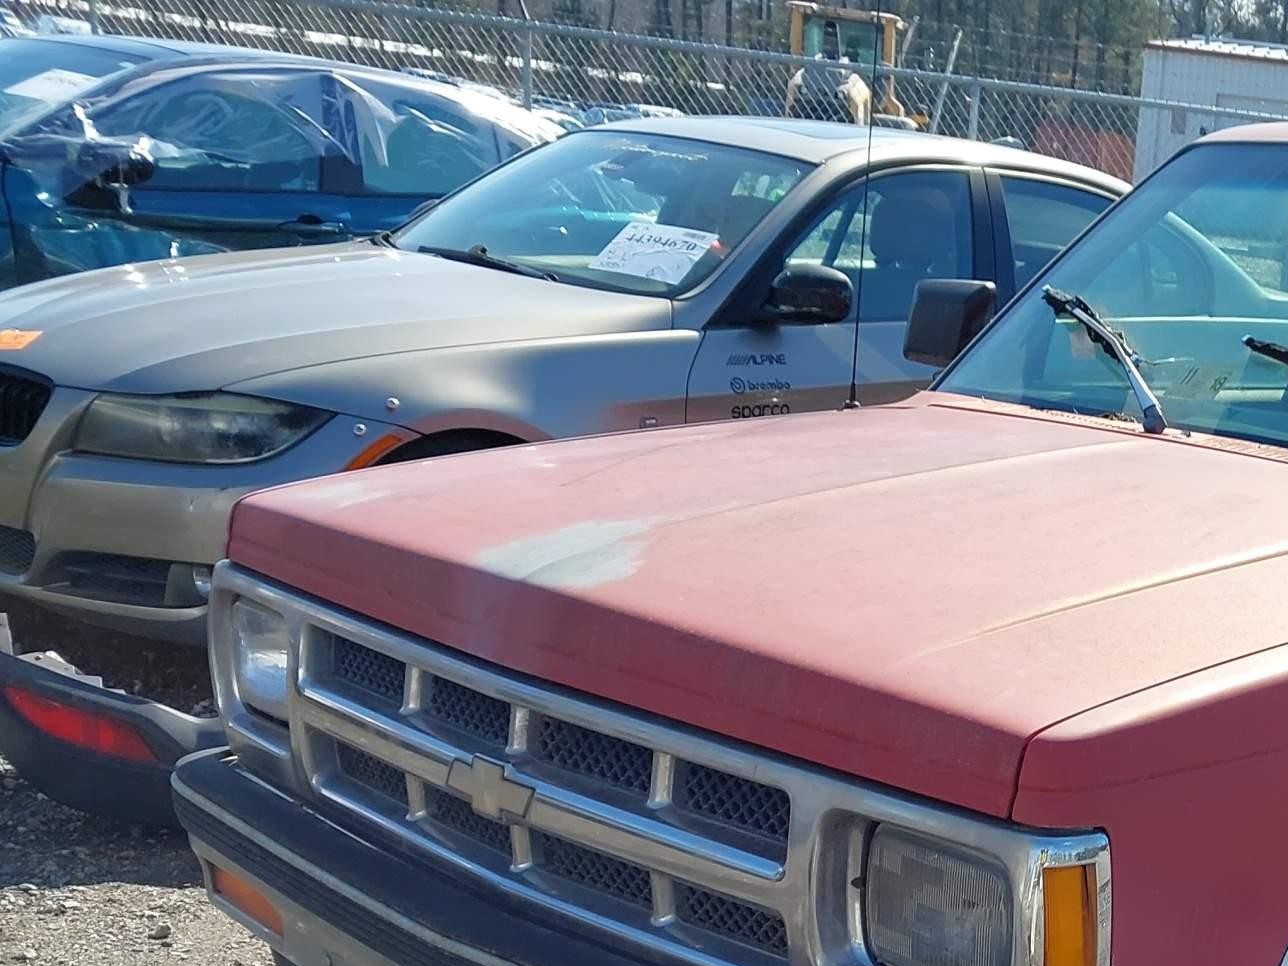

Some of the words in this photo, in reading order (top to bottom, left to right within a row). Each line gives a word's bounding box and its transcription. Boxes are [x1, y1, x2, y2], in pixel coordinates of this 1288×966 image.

[743, 354, 787, 365] ALPINE
[746, 378, 791, 391] brembo
[731, 404, 790, 419] sparco
